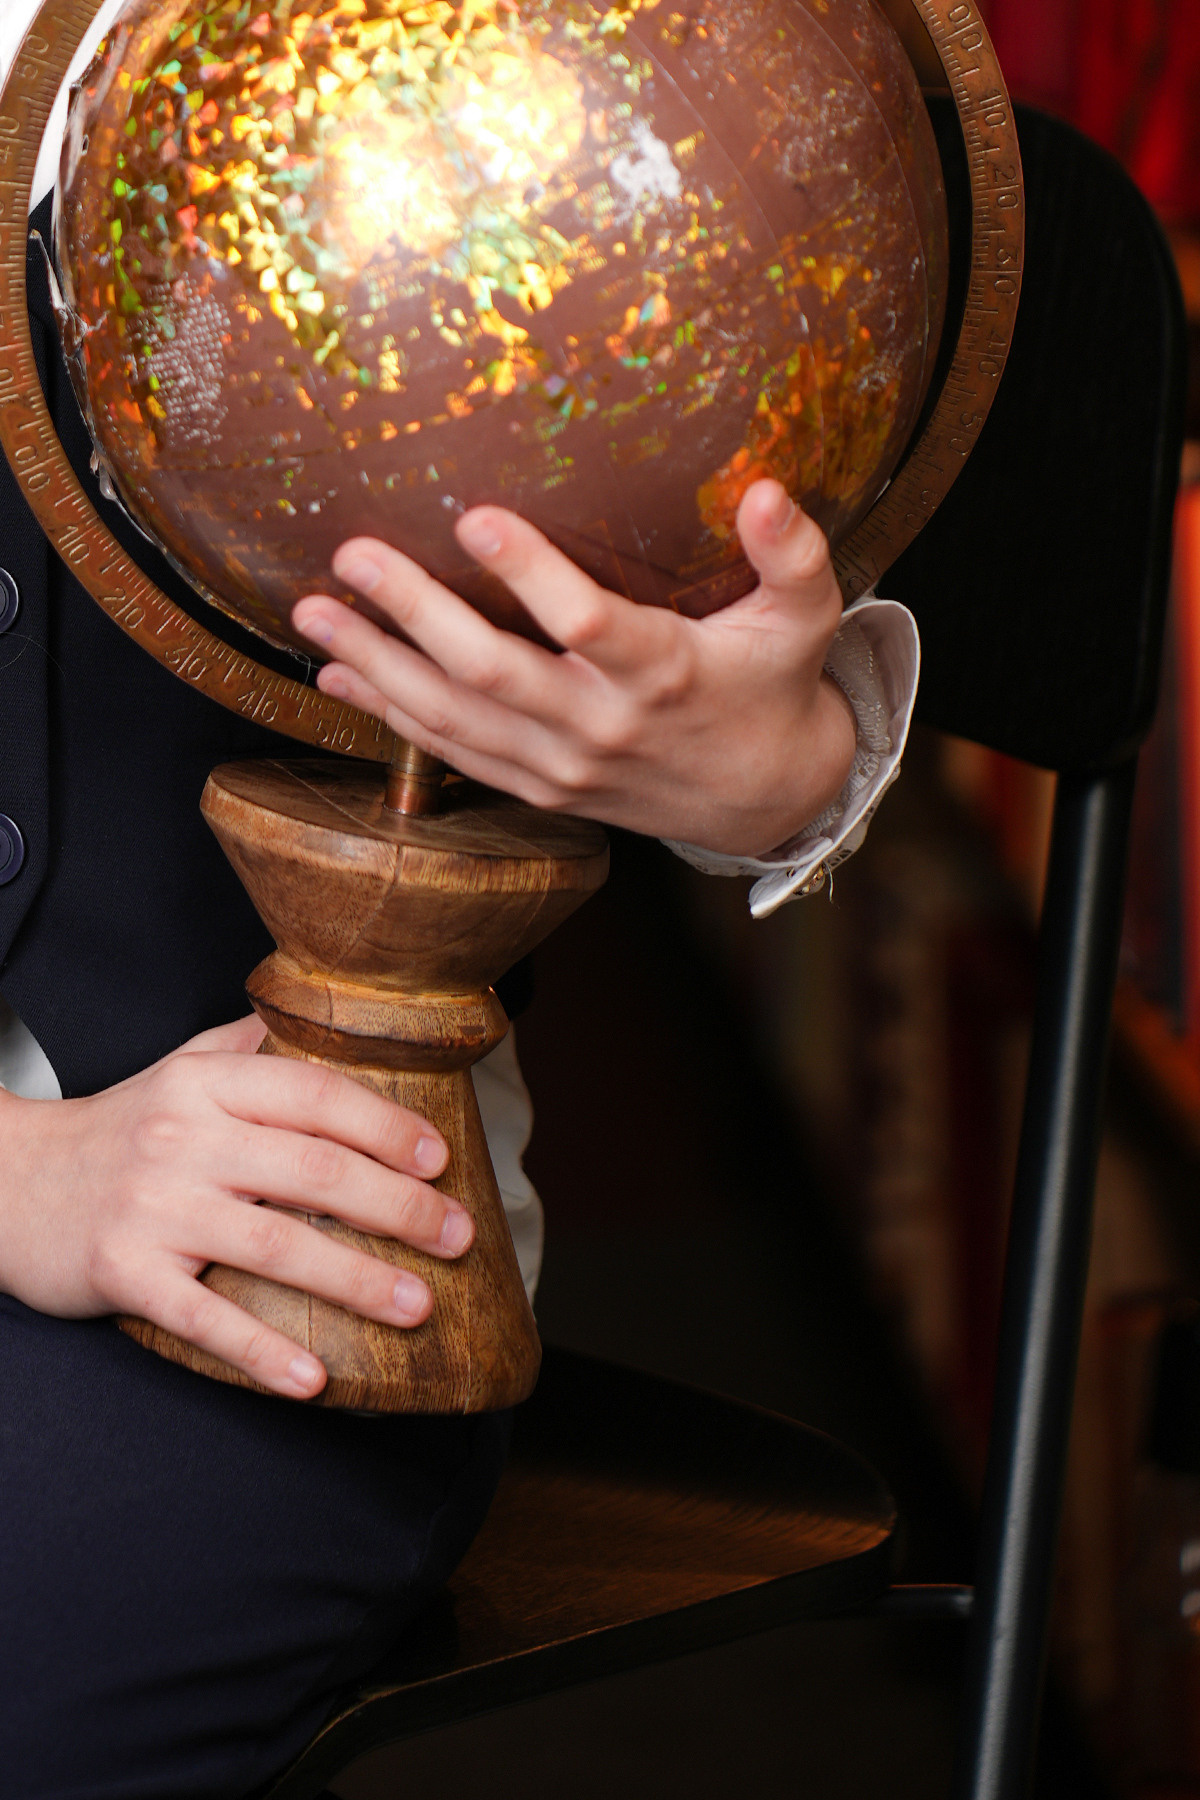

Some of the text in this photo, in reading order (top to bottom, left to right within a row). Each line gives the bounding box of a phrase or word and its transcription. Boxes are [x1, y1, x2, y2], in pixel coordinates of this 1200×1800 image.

[949, 4, 983, 52] 00
[15, 33, 50, 80] 50
[979, 93, 1006, 128] 10
[993, 164, 1019, 210] 20
[994, 248, 1018, 295] 30
[978, 331, 1007, 377] 40
[14, 444, 50, 492] 00
[58, 525, 90, 564] 10
[103, 587, 146, 629] 20
[164, 647, 207, 681] 30
[237, 690, 279, 723] 40
[315, 718, 356, 751] 50
